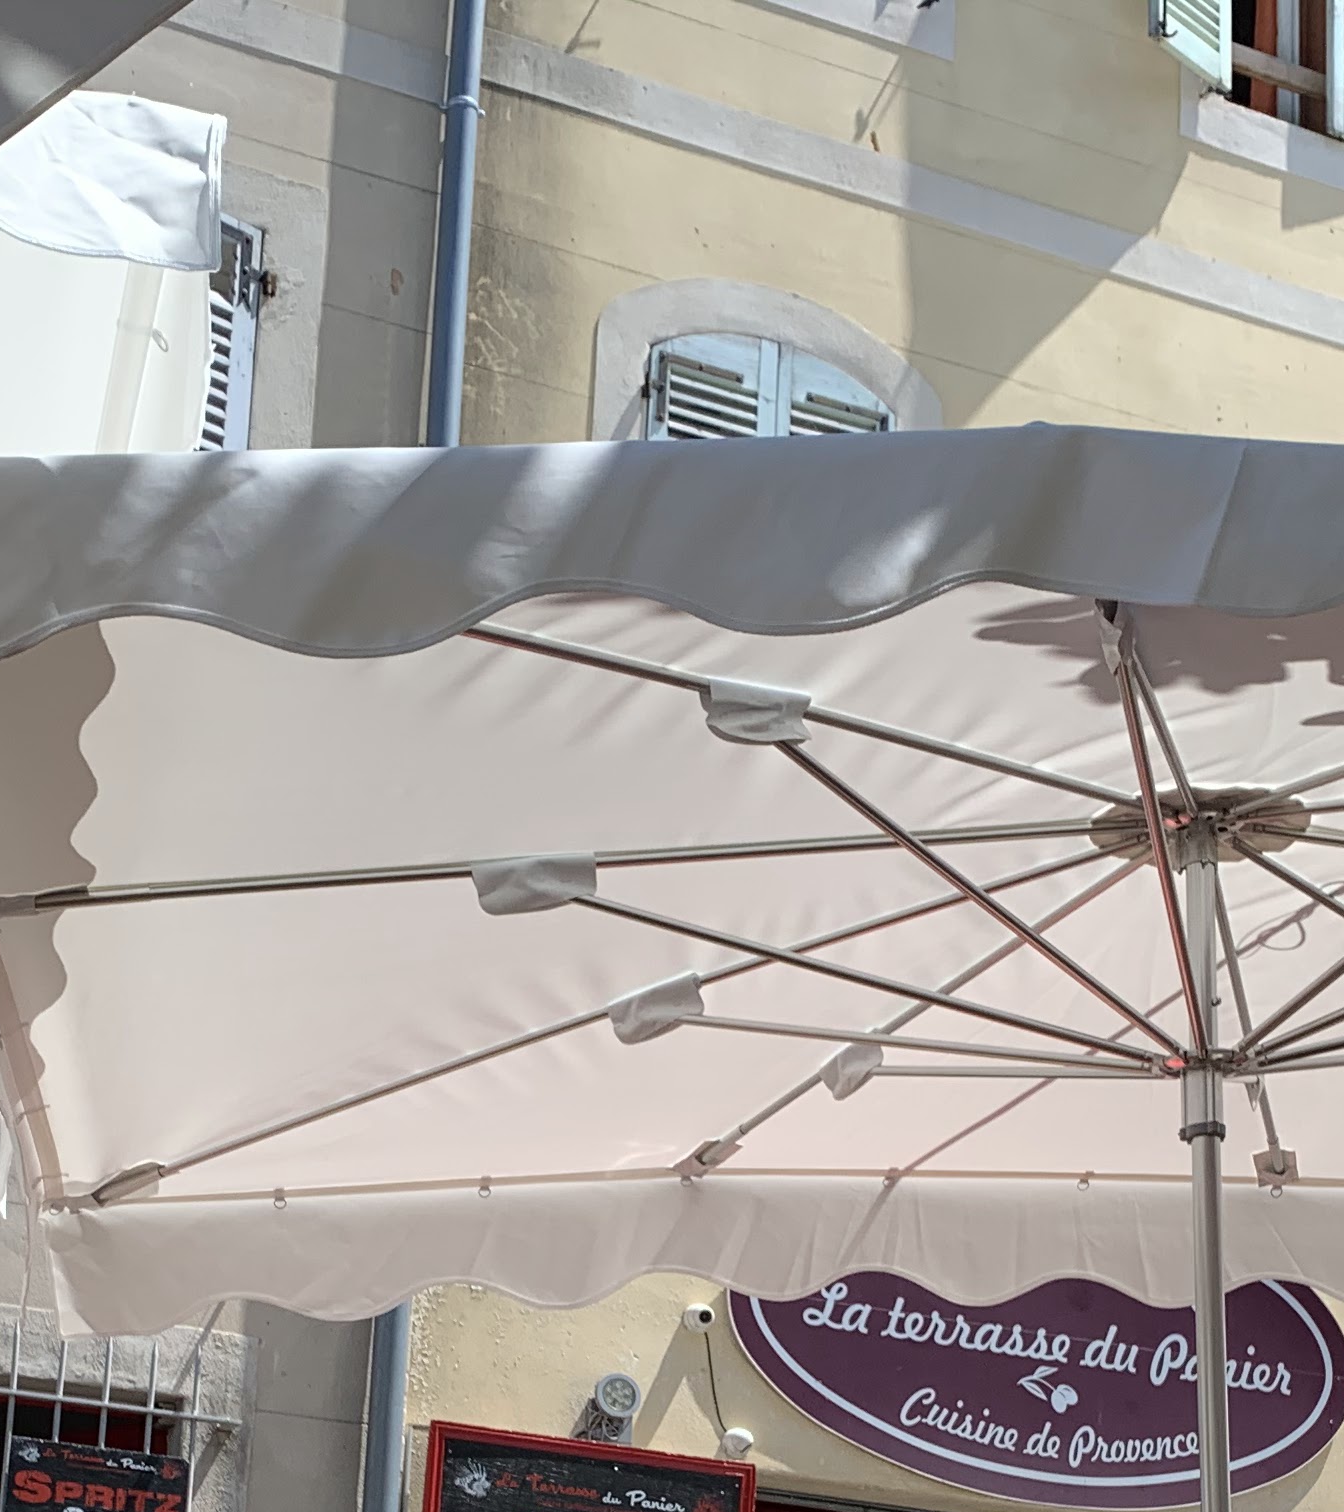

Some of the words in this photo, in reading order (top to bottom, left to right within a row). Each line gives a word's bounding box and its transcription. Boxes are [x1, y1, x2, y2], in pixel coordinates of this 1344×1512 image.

[803, 1282, 871, 1334] La
[881, 1297, 1070, 1363] terrasse
[1079, 1325, 1138, 1373] du
[900, 1388, 1018, 1451] Cuisine
[1023, 1421, 1059, 1458] de
[1069, 1425, 1199, 1468] Provence
[602, 1491, 622, 1504] du
[625, 1490, 685, 1512] Panier
